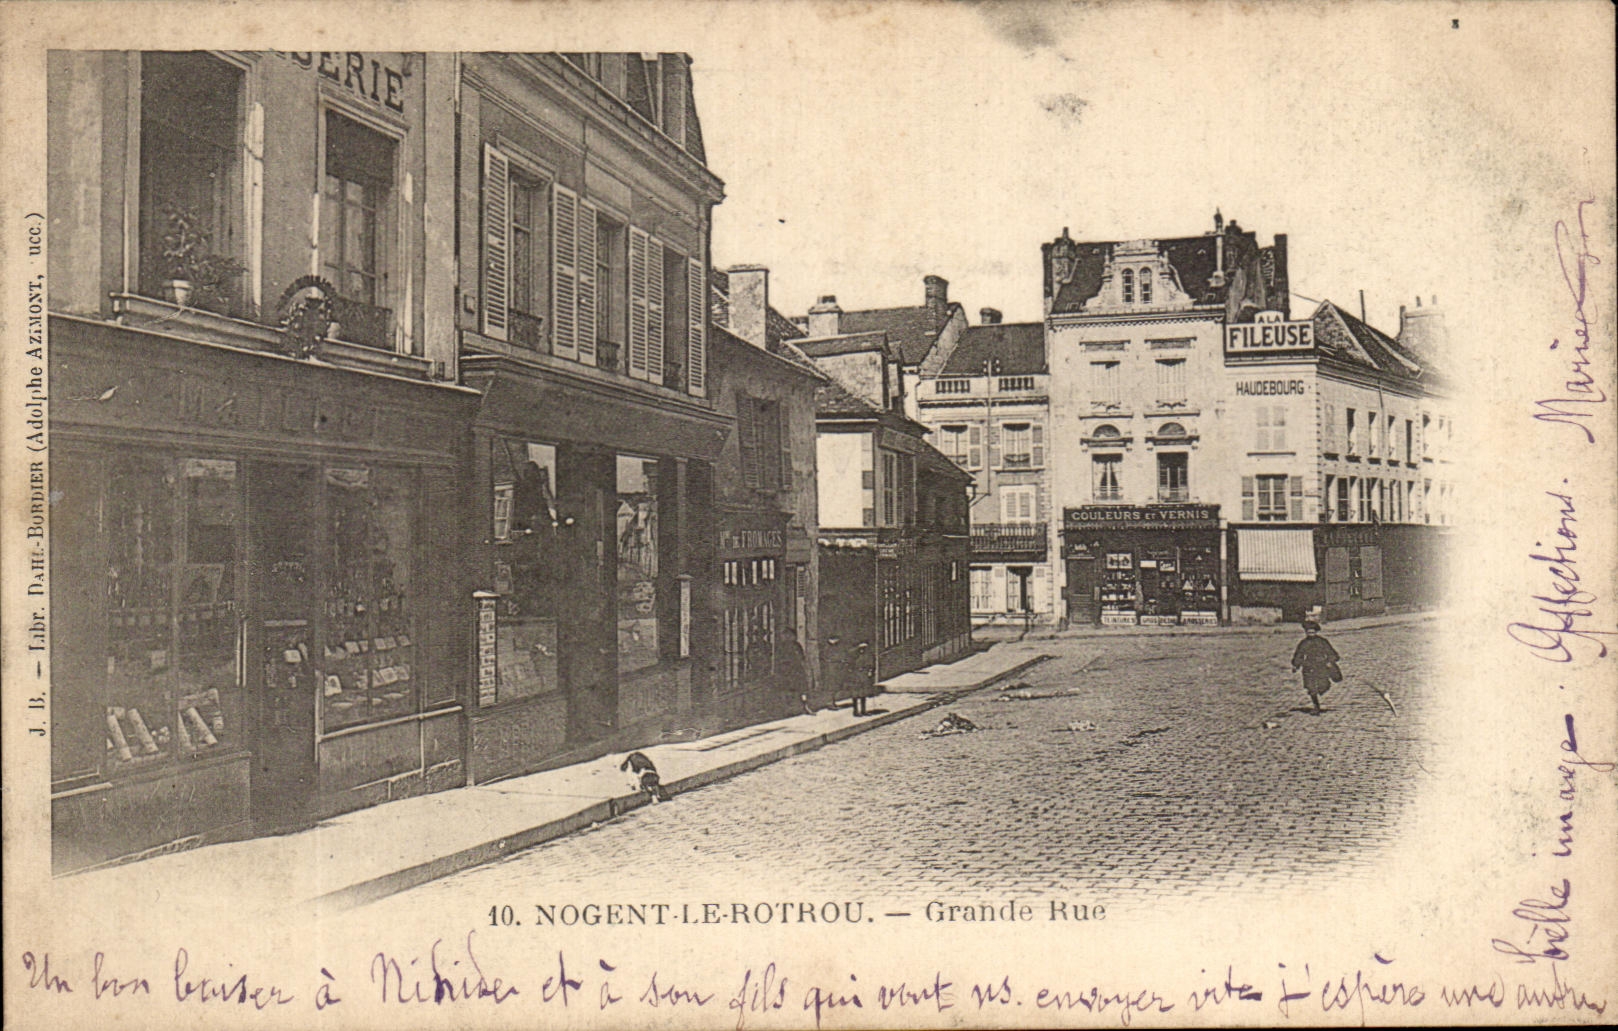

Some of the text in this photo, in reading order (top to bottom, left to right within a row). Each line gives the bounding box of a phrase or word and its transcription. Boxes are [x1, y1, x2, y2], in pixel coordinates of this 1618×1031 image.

[1229, 324, 1311, 348] FILEUSE
[1236, 380, 1304, 395] HAUDEBOURG
[1072, 511, 1140, 521] COULEURS
[1159, 510, 1209, 520] VERNIS
[23, 951, 73, 994] Un
[92, 952, 150, 1000] bon
[315, 967, 341, 1010] à
[542, 950, 583, 1007] et
[599, 959, 623, 1010] à
[640, 971, 715, 1008] son
[729, 962, 788, 1030] fils
[803, 973, 863, 1029] qui
[1037, 987, 1175, 1026] envoyer
